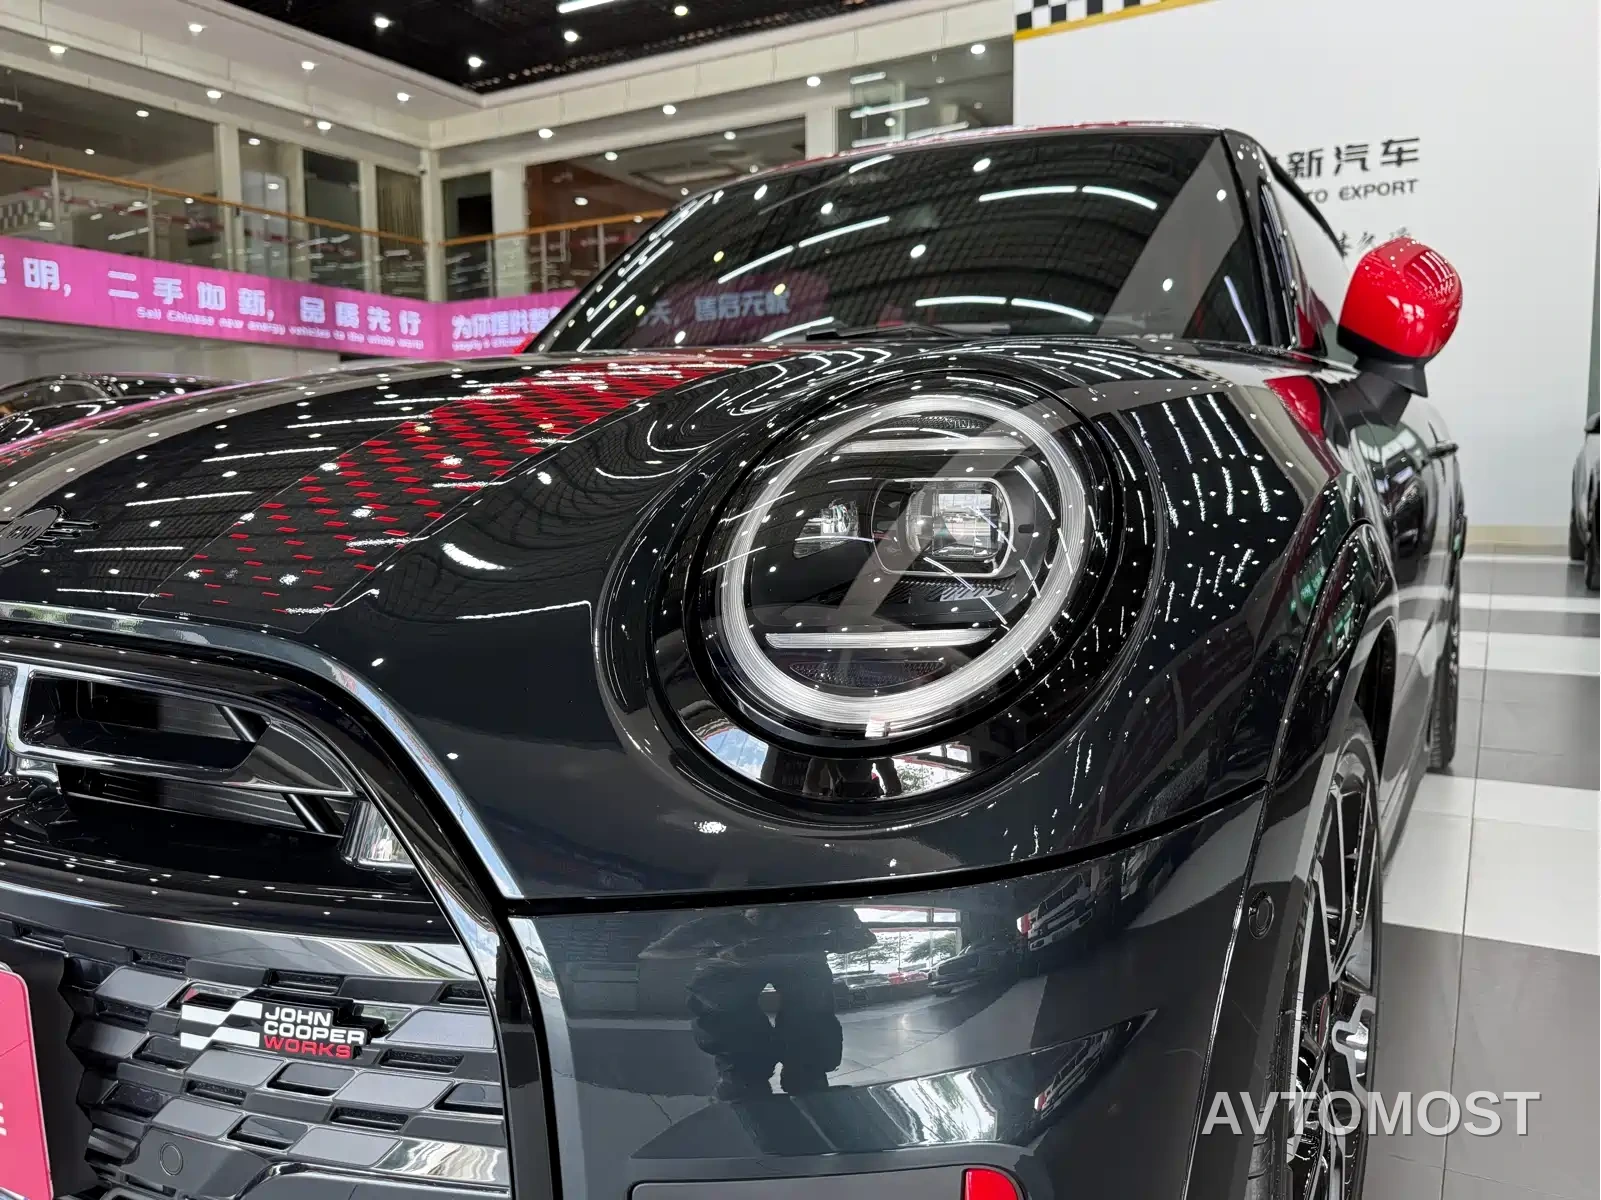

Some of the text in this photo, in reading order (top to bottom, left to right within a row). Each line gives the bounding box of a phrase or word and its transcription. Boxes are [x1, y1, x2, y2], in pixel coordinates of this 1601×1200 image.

[1273, 136, 1420, 179] 新汽车
[1304, 178, 1419, 204] TO EXPORT
[264, 1006, 333, 1028] JOHN
[263, 1020, 366, 1046] COOPER
[263, 1035, 352, 1060] WORKS
